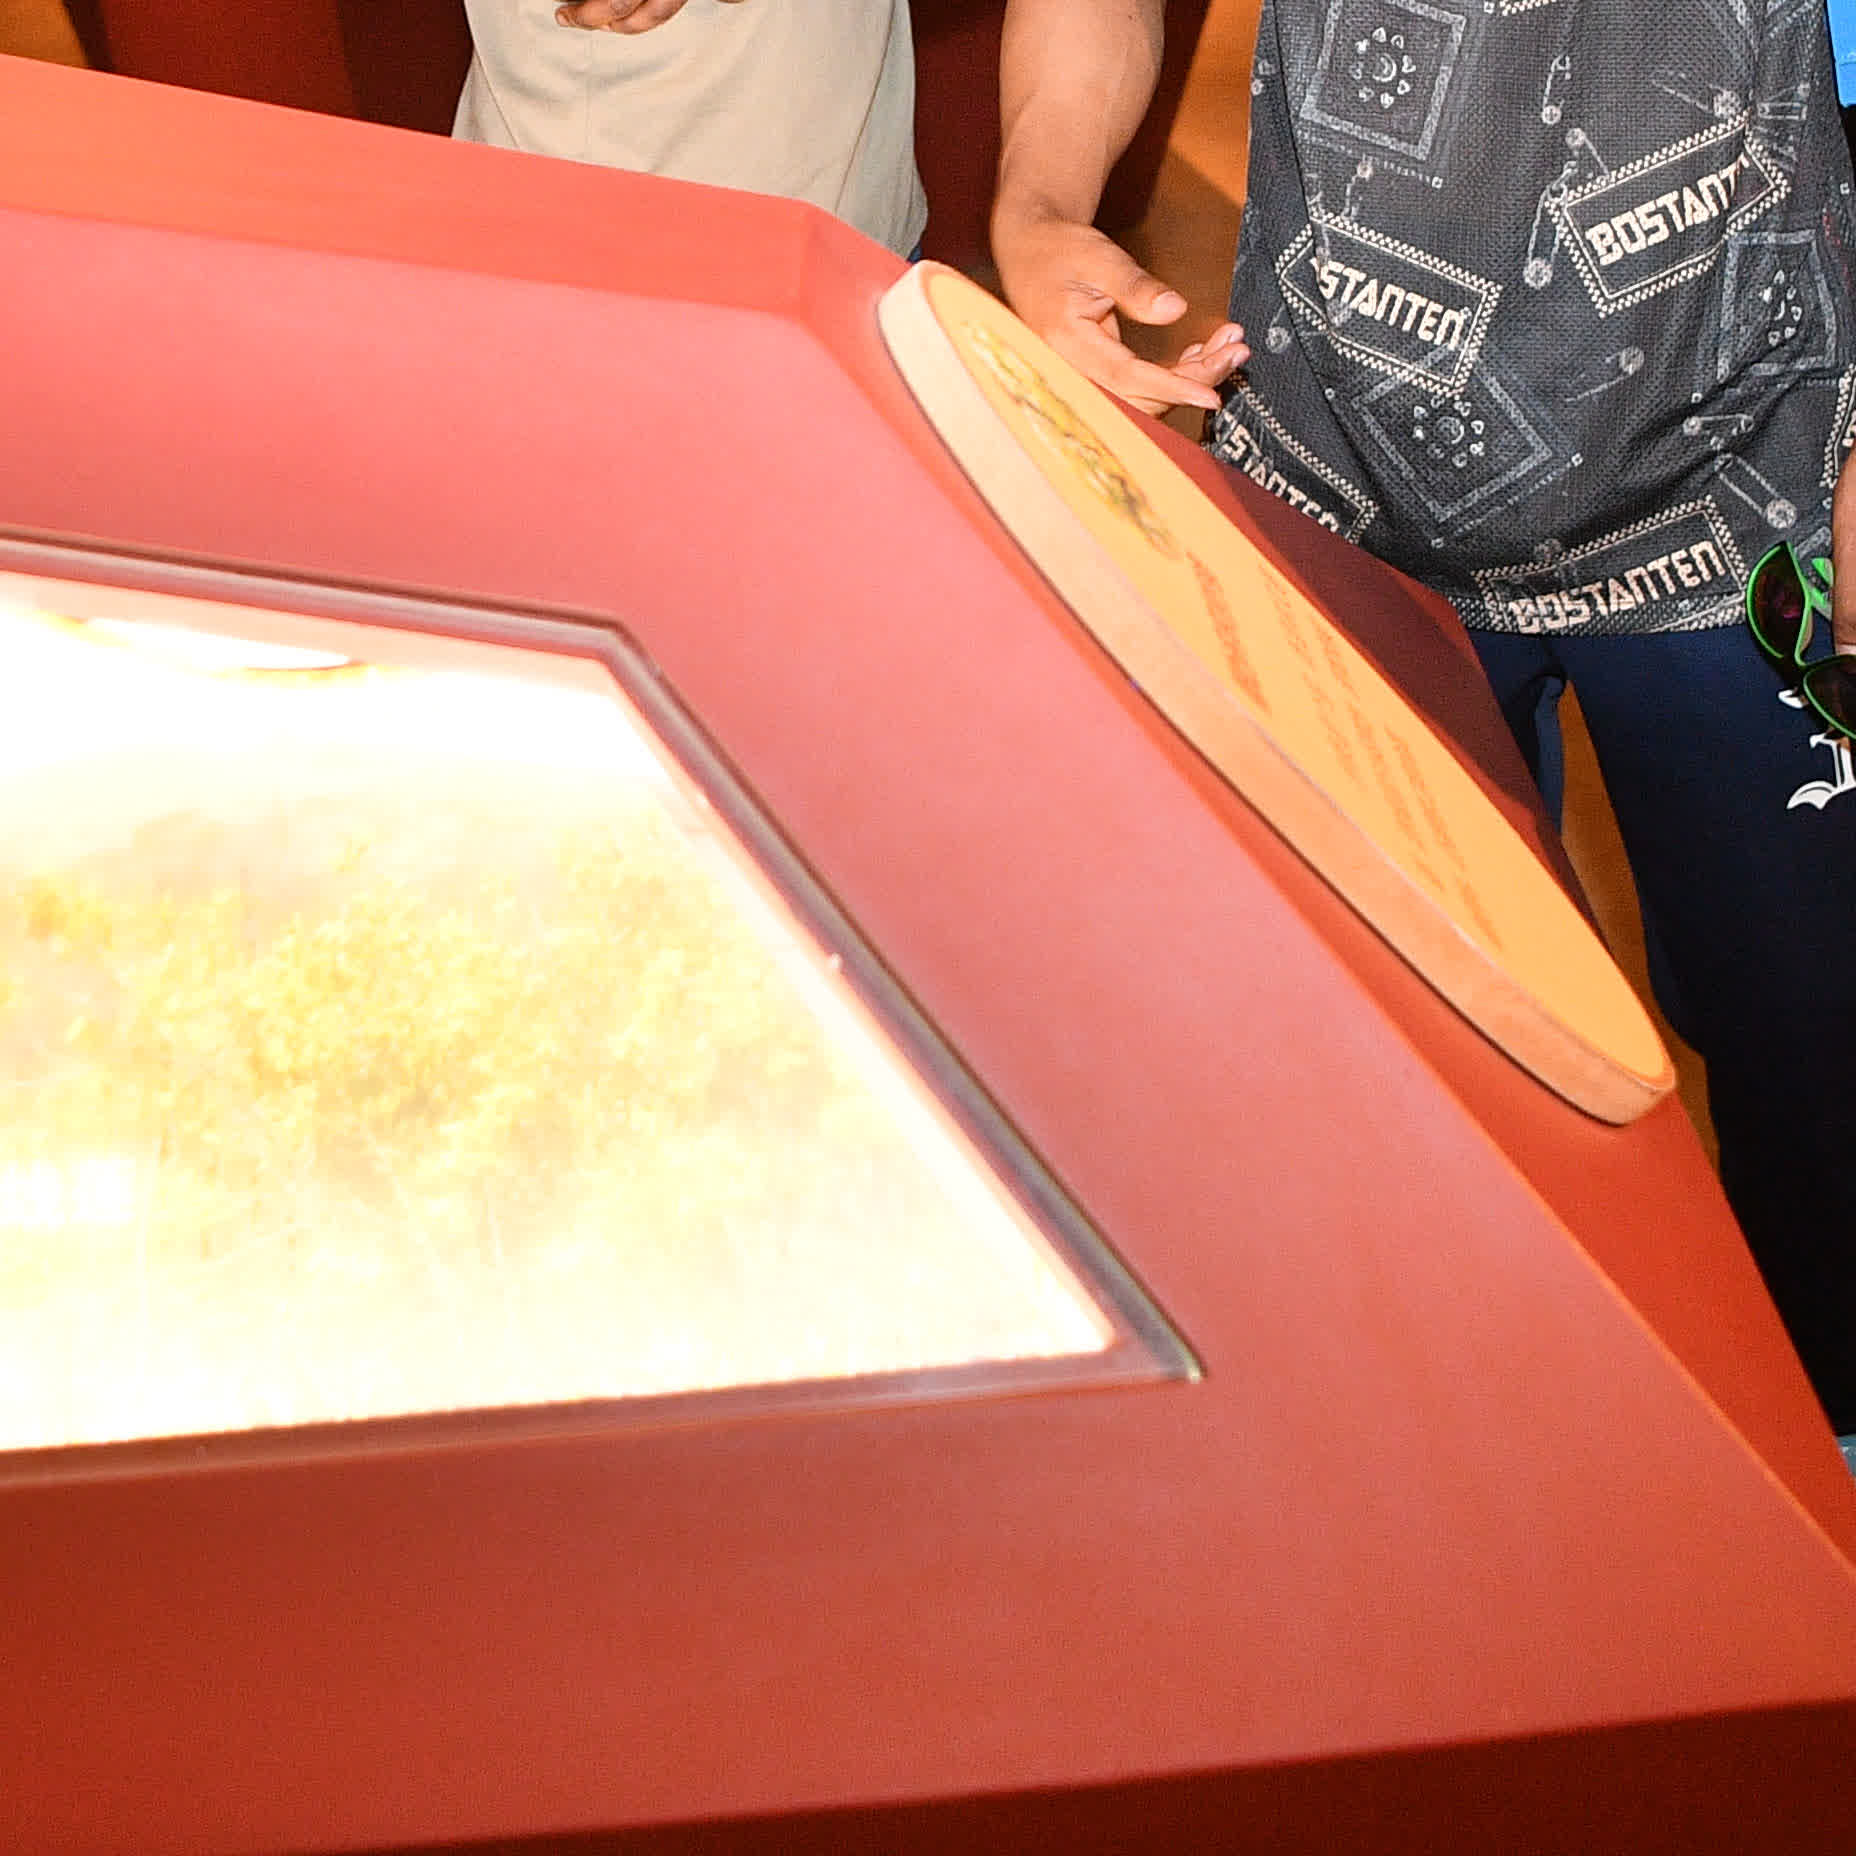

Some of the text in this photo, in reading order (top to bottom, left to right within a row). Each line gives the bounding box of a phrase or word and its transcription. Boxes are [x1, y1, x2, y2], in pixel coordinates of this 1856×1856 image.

[1585, 152, 1749, 267] BOSTANT
[1312, 256, 1466, 351] STANTEN
[1508, 539, 1726, 635] BOSTANTEN
